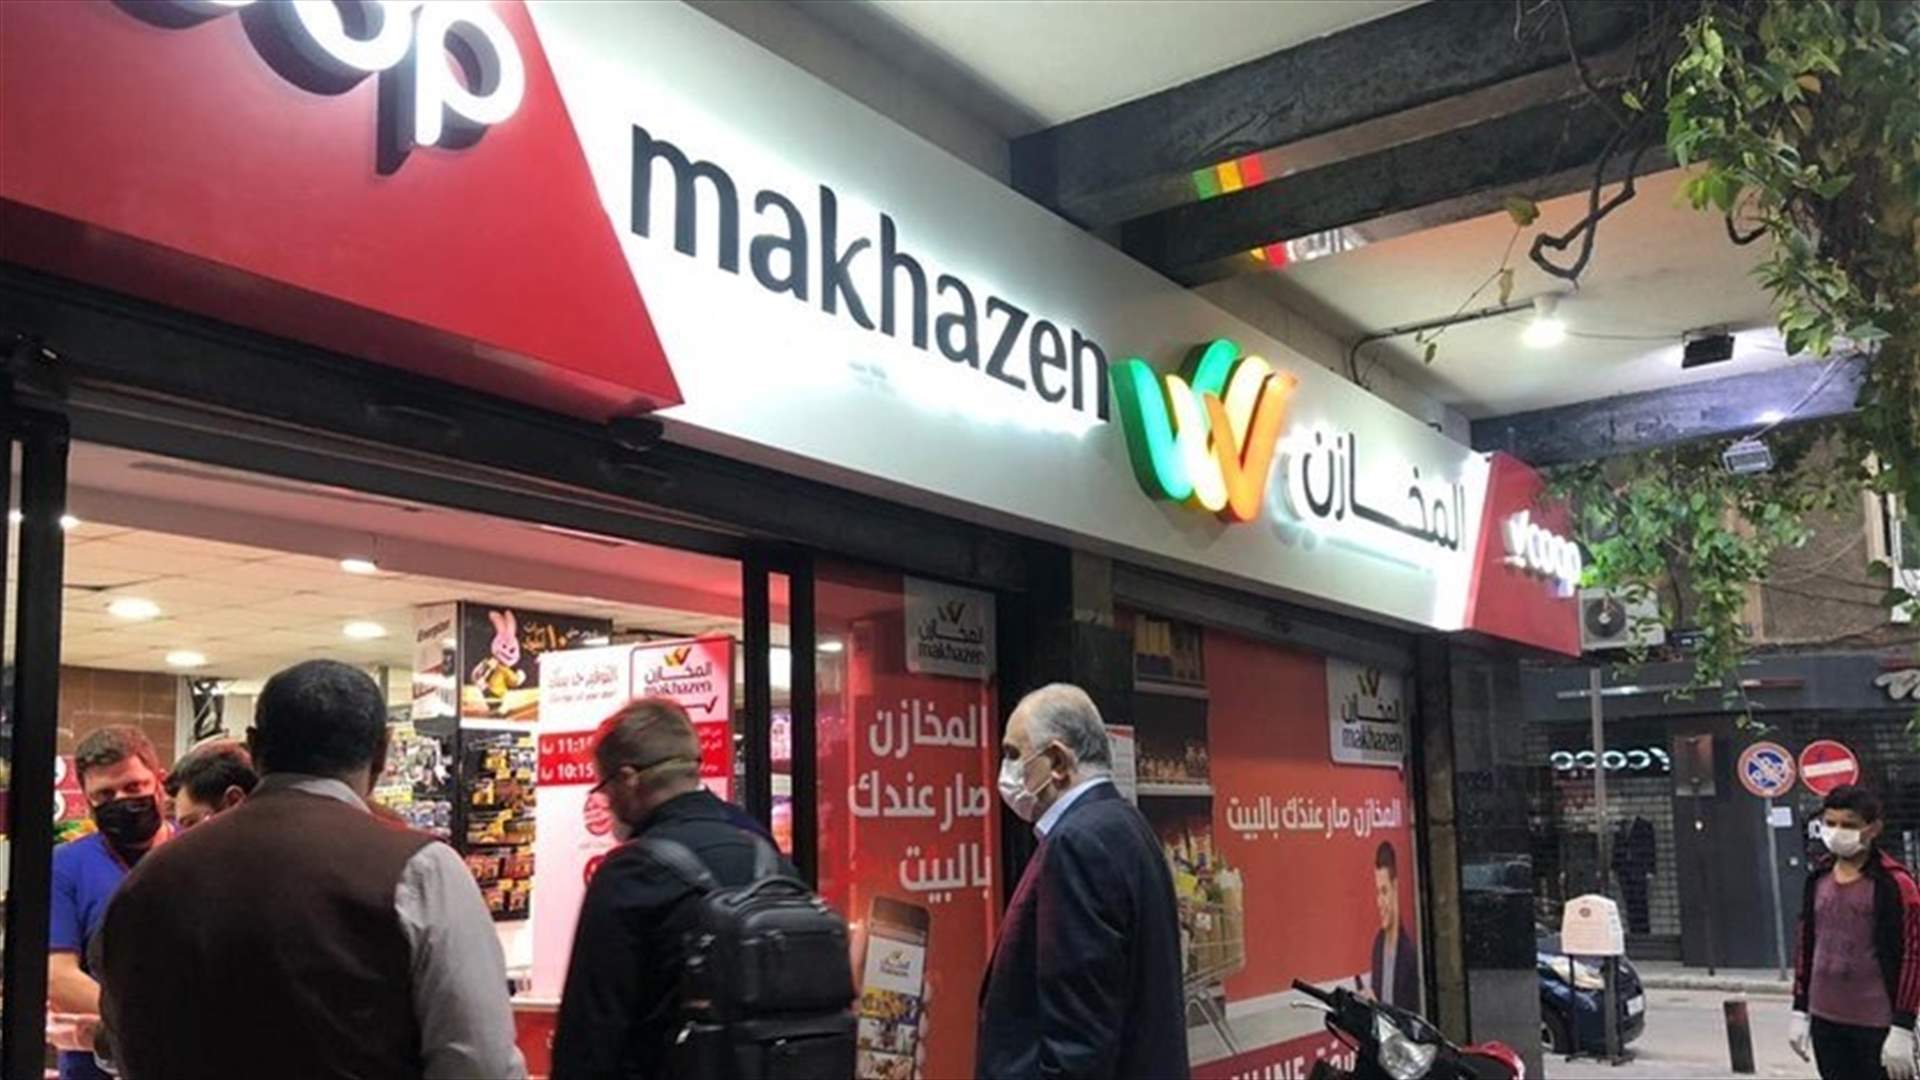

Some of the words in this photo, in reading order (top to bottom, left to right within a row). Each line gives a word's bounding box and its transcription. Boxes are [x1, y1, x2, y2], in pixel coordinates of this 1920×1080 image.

[631, 123, 1111, 423] makhazen
[1303, 431, 1466, 551] المخازن
[869, 699, 988, 759] المخازن
[1342, 724, 1403, 753] makhazen
[557, 762, 595, 781] 10:15
[848, 769, 935, 818] عندك
[939, 772, 991, 832] صار
[1226, 797, 1281, 840] بالبيت
[1282, 797, 1326, 830] عندك
[1324, 797, 1351, 839] صار
[1354, 798, 1402, 837] المخازن
[899, 843, 992, 904] بالبيت
